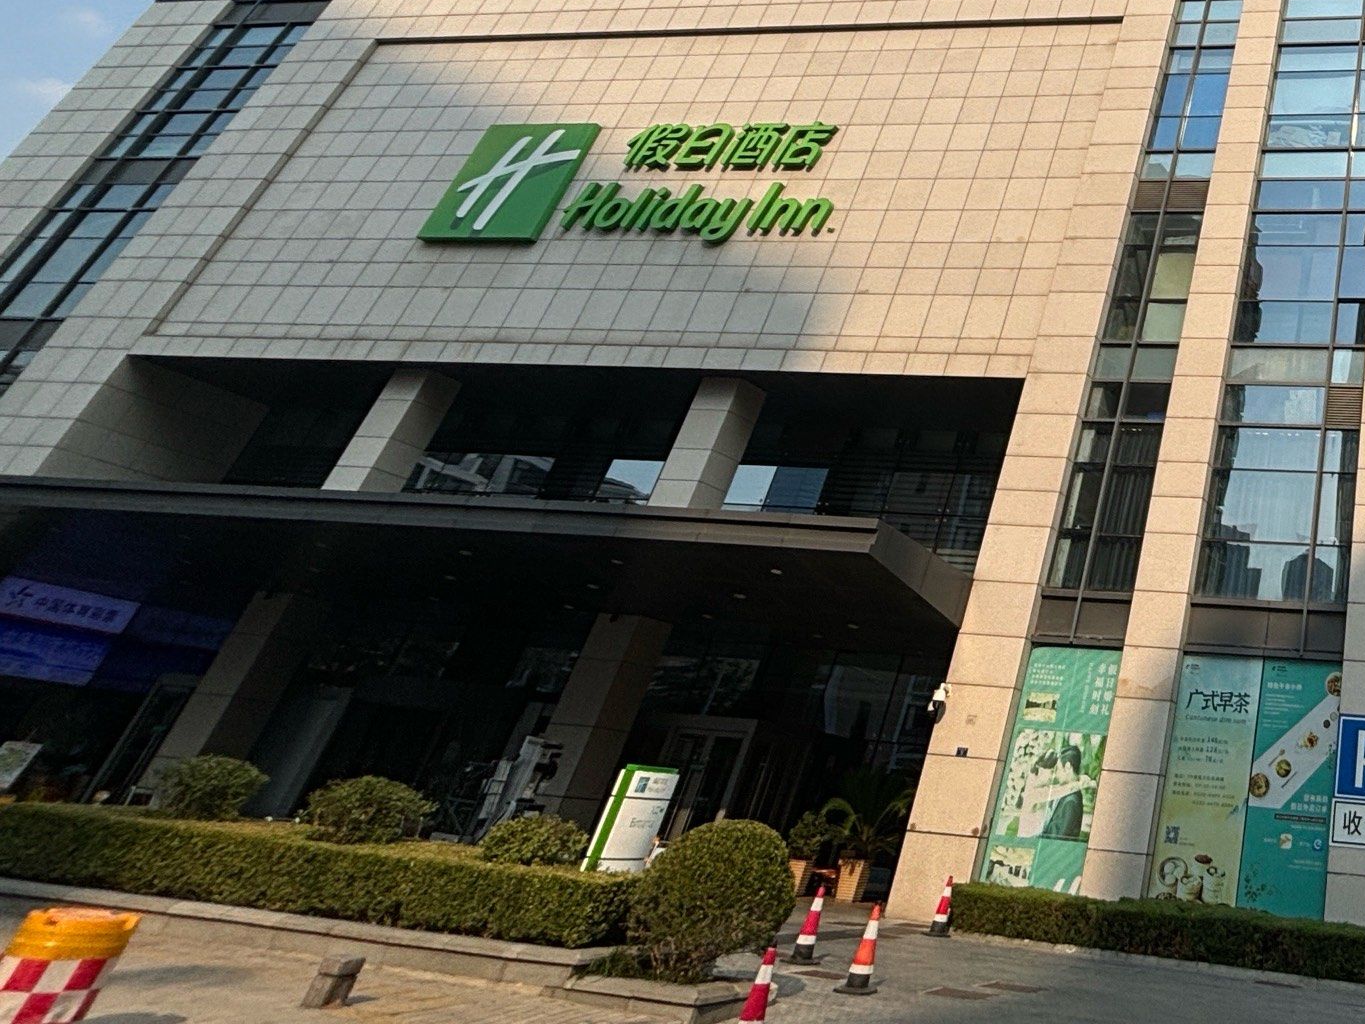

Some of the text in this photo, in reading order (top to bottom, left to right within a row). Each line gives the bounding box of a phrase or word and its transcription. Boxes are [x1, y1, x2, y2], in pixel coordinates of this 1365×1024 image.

[625, 121, 840, 172] 假日酒店
[560, 182, 755, 247] Holiday
[1185, 688, 1251, 714] 广式早茶
